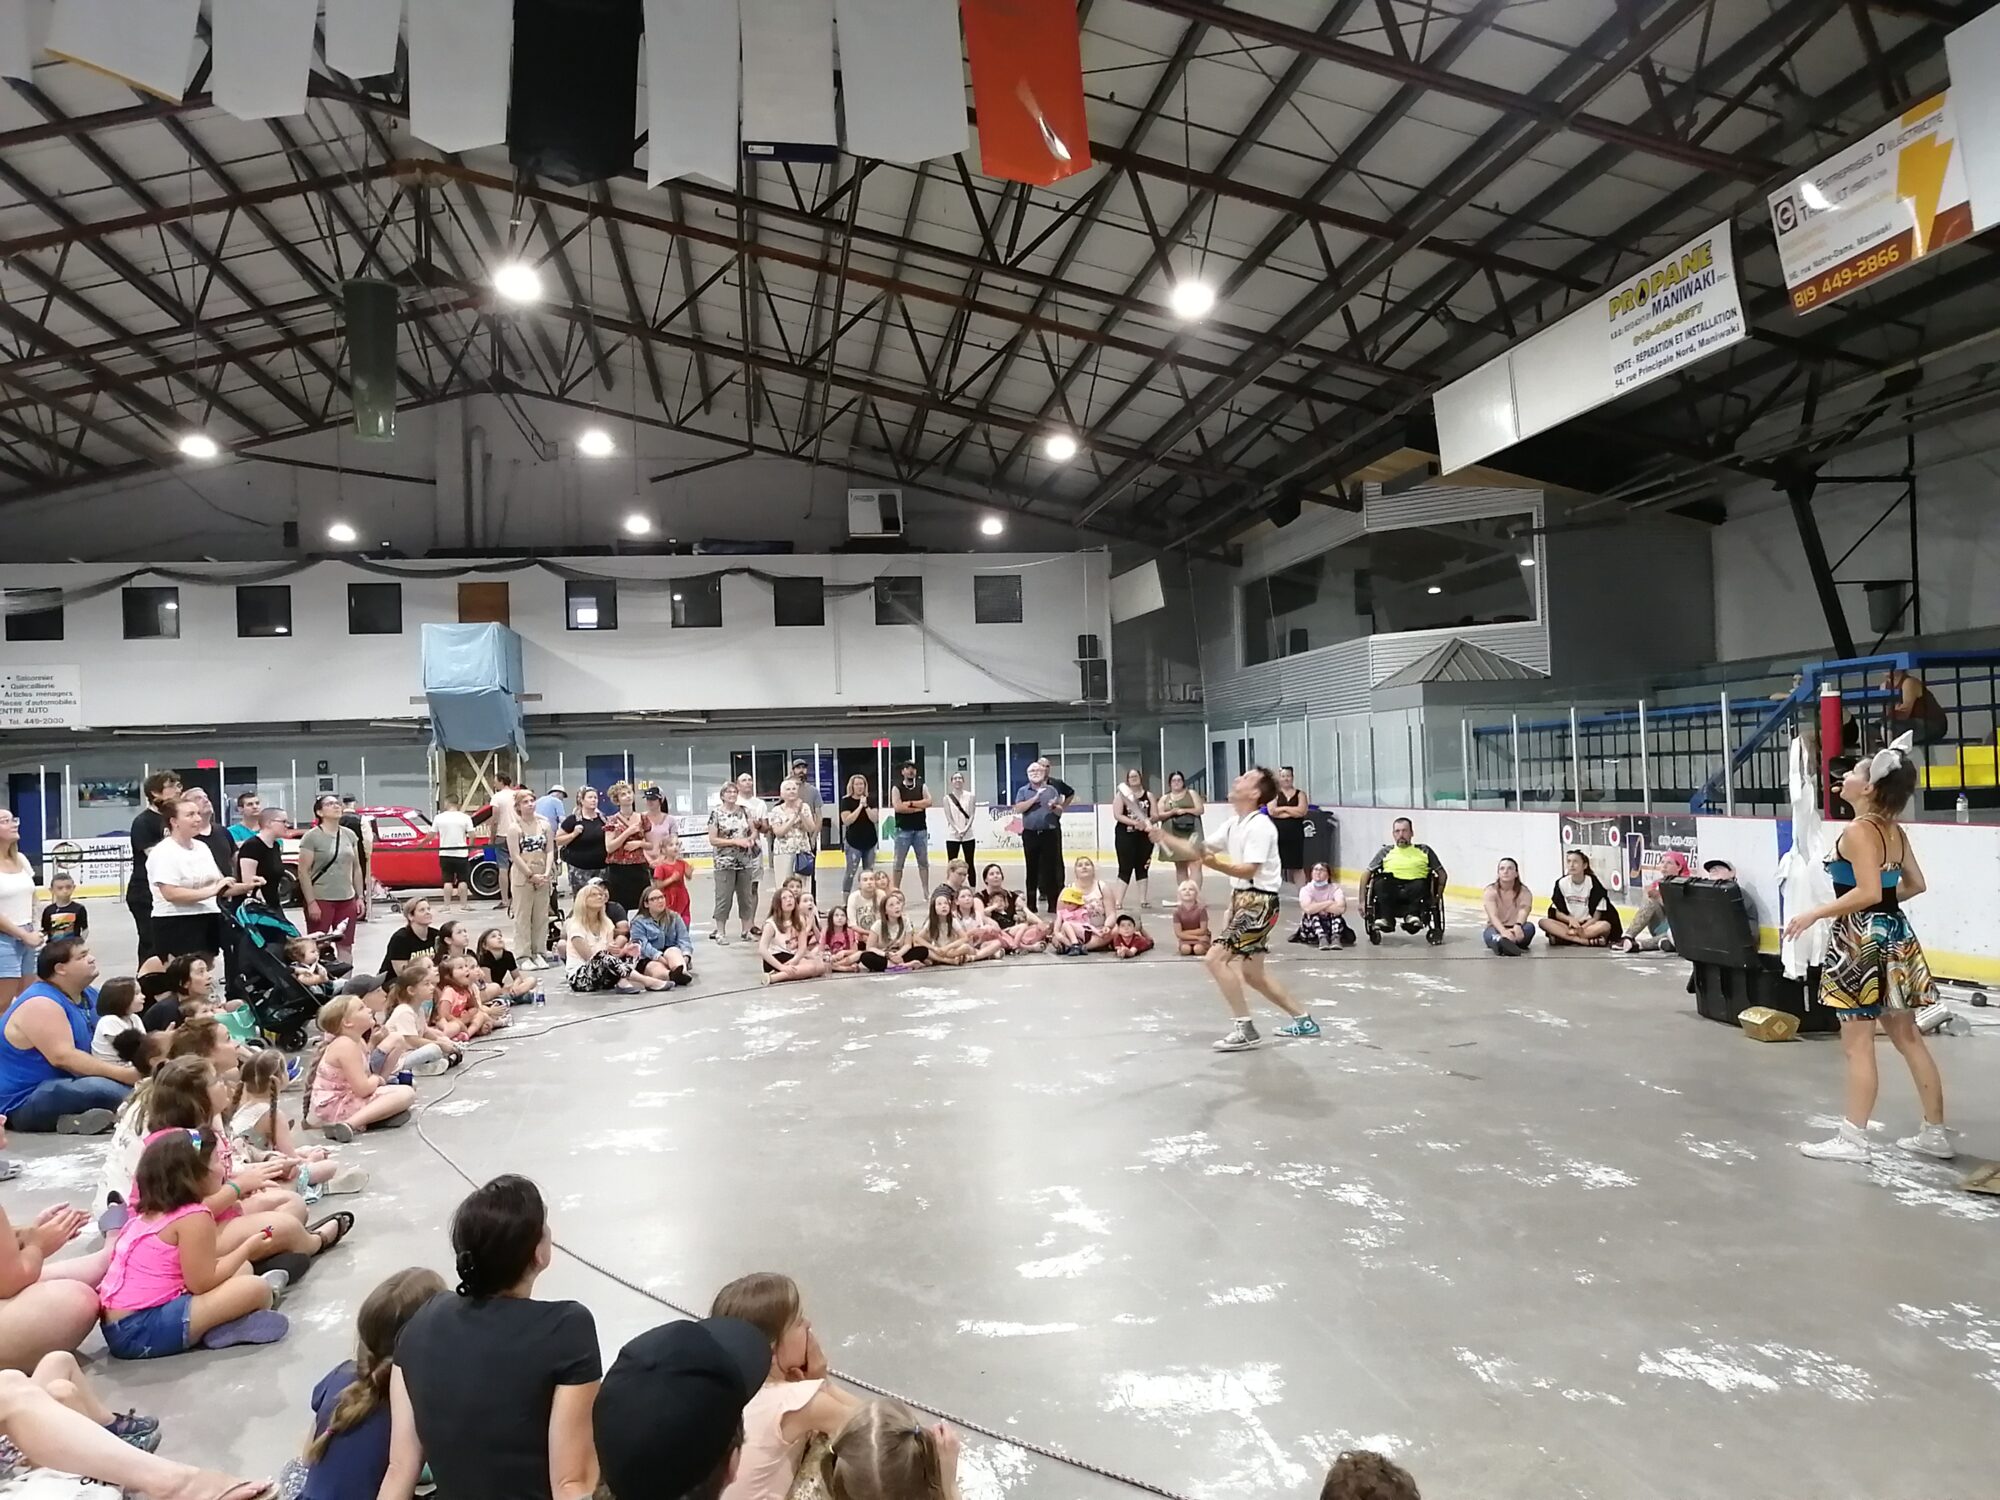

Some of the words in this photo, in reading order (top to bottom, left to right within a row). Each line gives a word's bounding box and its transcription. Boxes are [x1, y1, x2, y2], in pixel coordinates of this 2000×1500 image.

[1608, 239, 1713, 322] PROPANE
[1652, 269, 1716, 317] MANIWAKI
[1793, 286, 1817, 308] 819
[1822, 244, 1900, 293] 449-2866
[1613, 357, 1632, 375] VENTE
[1675, 331, 1684, 345] ET
[1685, 307, 1738, 339] INSTALLATION
[1626, 372, 1637, 383] rue
[1638, 354, 1674, 377] Principale
[1675, 343, 1697, 359] Nord,
[1698, 323, 1740, 347] Maniwaki
